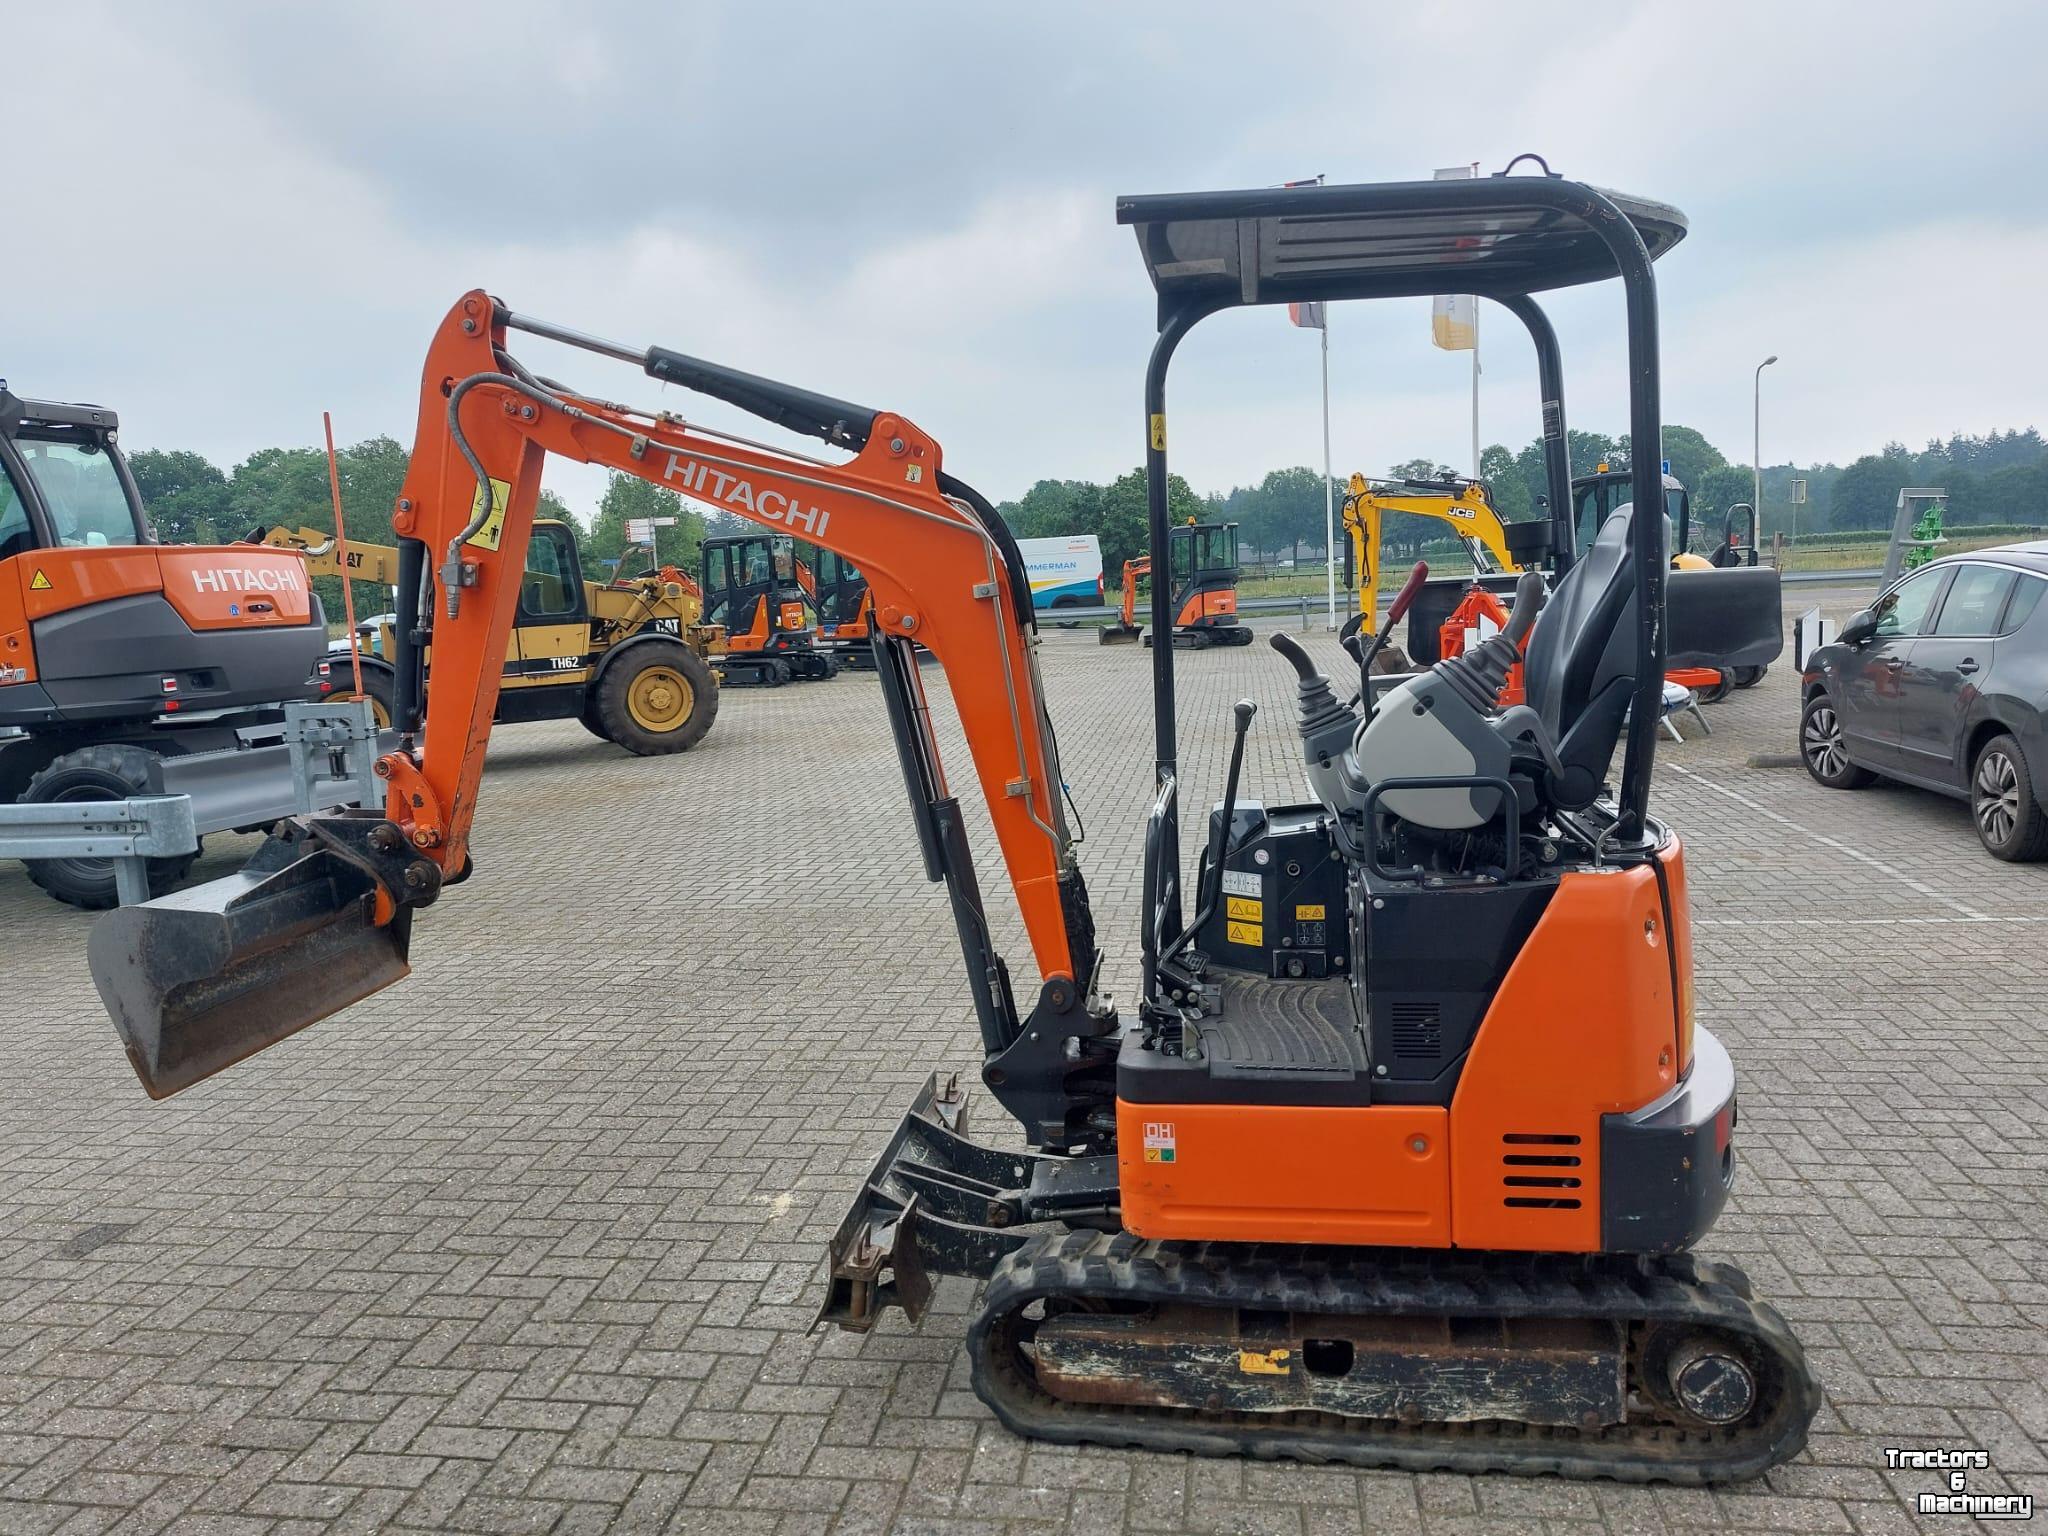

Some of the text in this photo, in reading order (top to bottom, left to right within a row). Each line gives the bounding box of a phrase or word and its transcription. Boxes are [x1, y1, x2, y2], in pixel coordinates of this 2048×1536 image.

[664, 454, 830, 538] HITACHI
[1448, 507, 1475, 519] JCB
[191, 569, 300, 593] HITACHI
[655, 619, 680, 634] CAT
[550, 656, 580, 669] TH62
